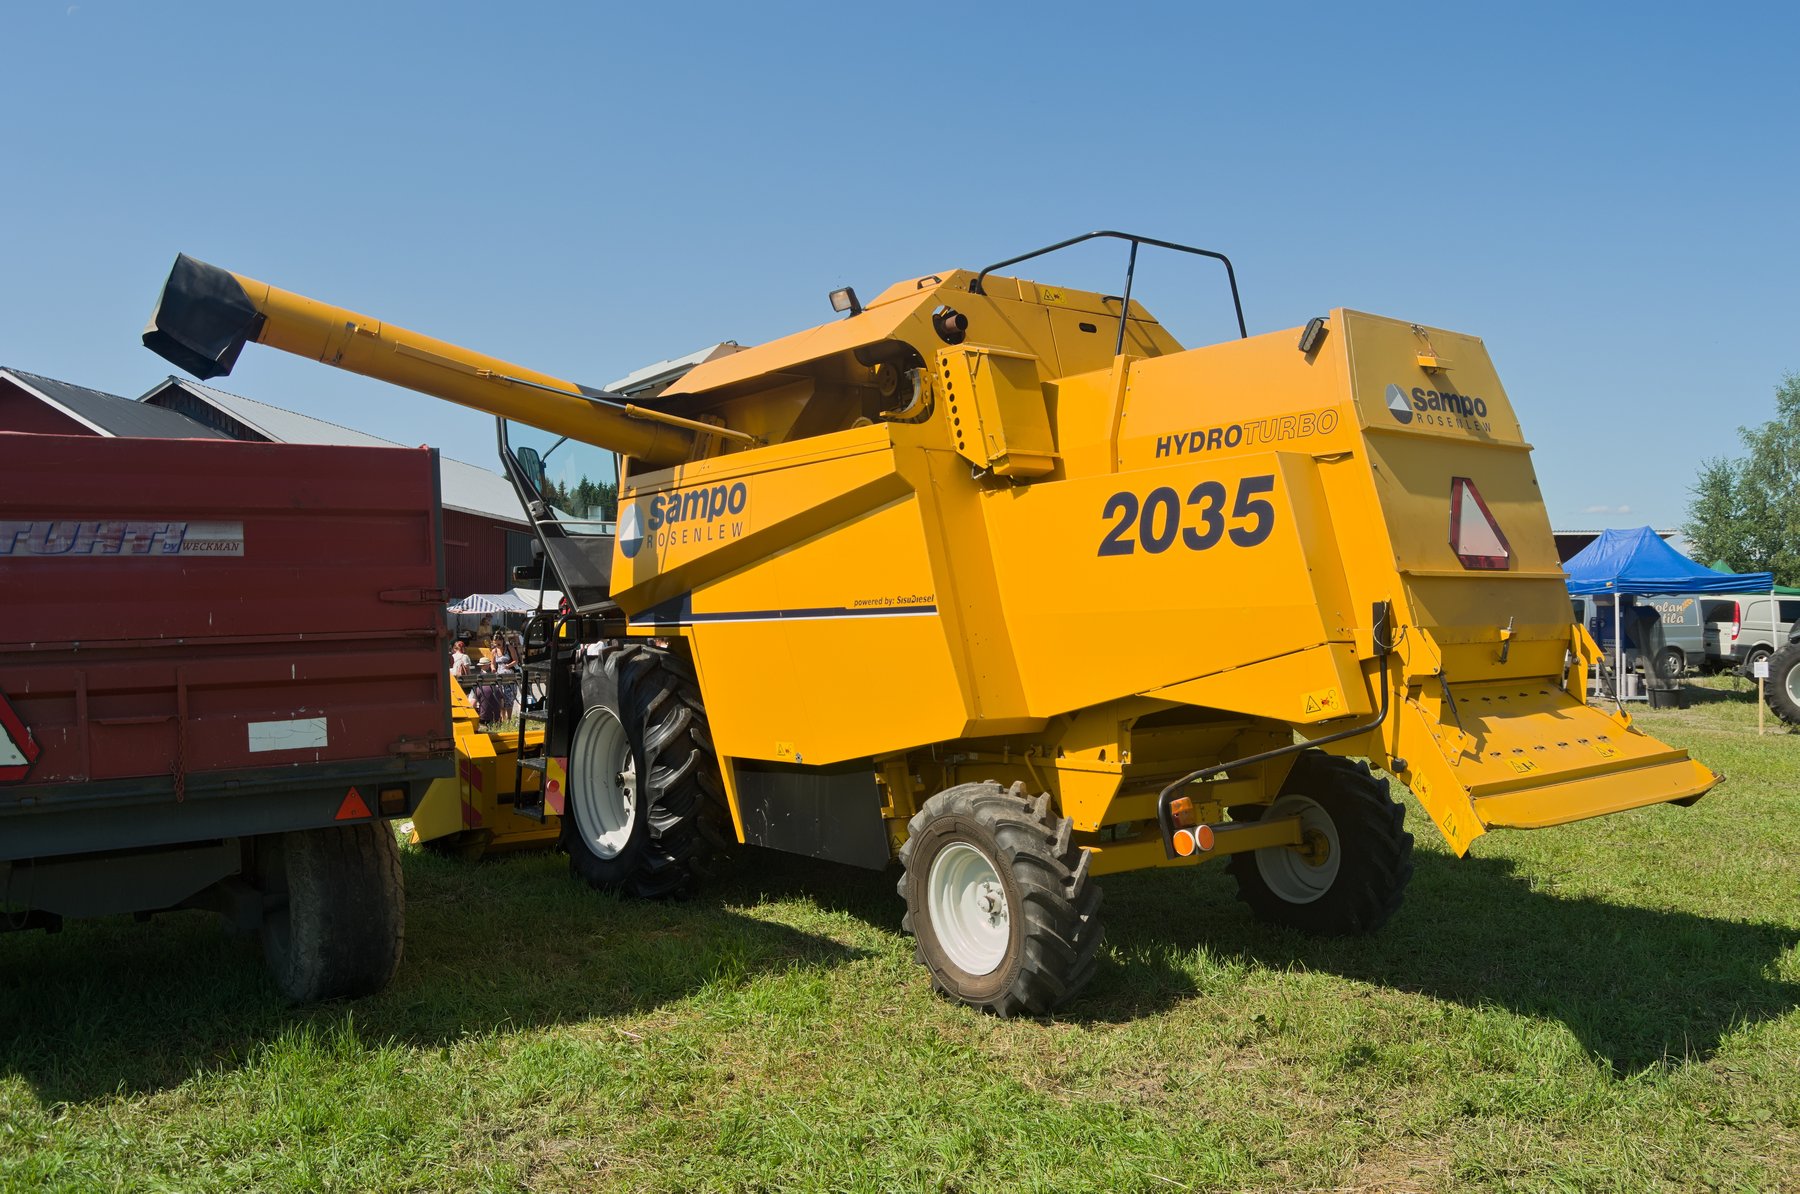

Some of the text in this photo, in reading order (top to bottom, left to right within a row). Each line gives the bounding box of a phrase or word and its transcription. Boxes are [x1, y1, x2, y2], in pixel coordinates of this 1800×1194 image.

[1416, 413, 1491, 432] ROSENLEW
[1097, 474, 1275, 557] 2035
[647, 521, 743, 549] ROSENLEW
[163, 541, 178, 551] by
[183, 542, 239, 551] WECKMAN
[854, 598, 882, 606] powered
[885, 596, 895, 606] by:
